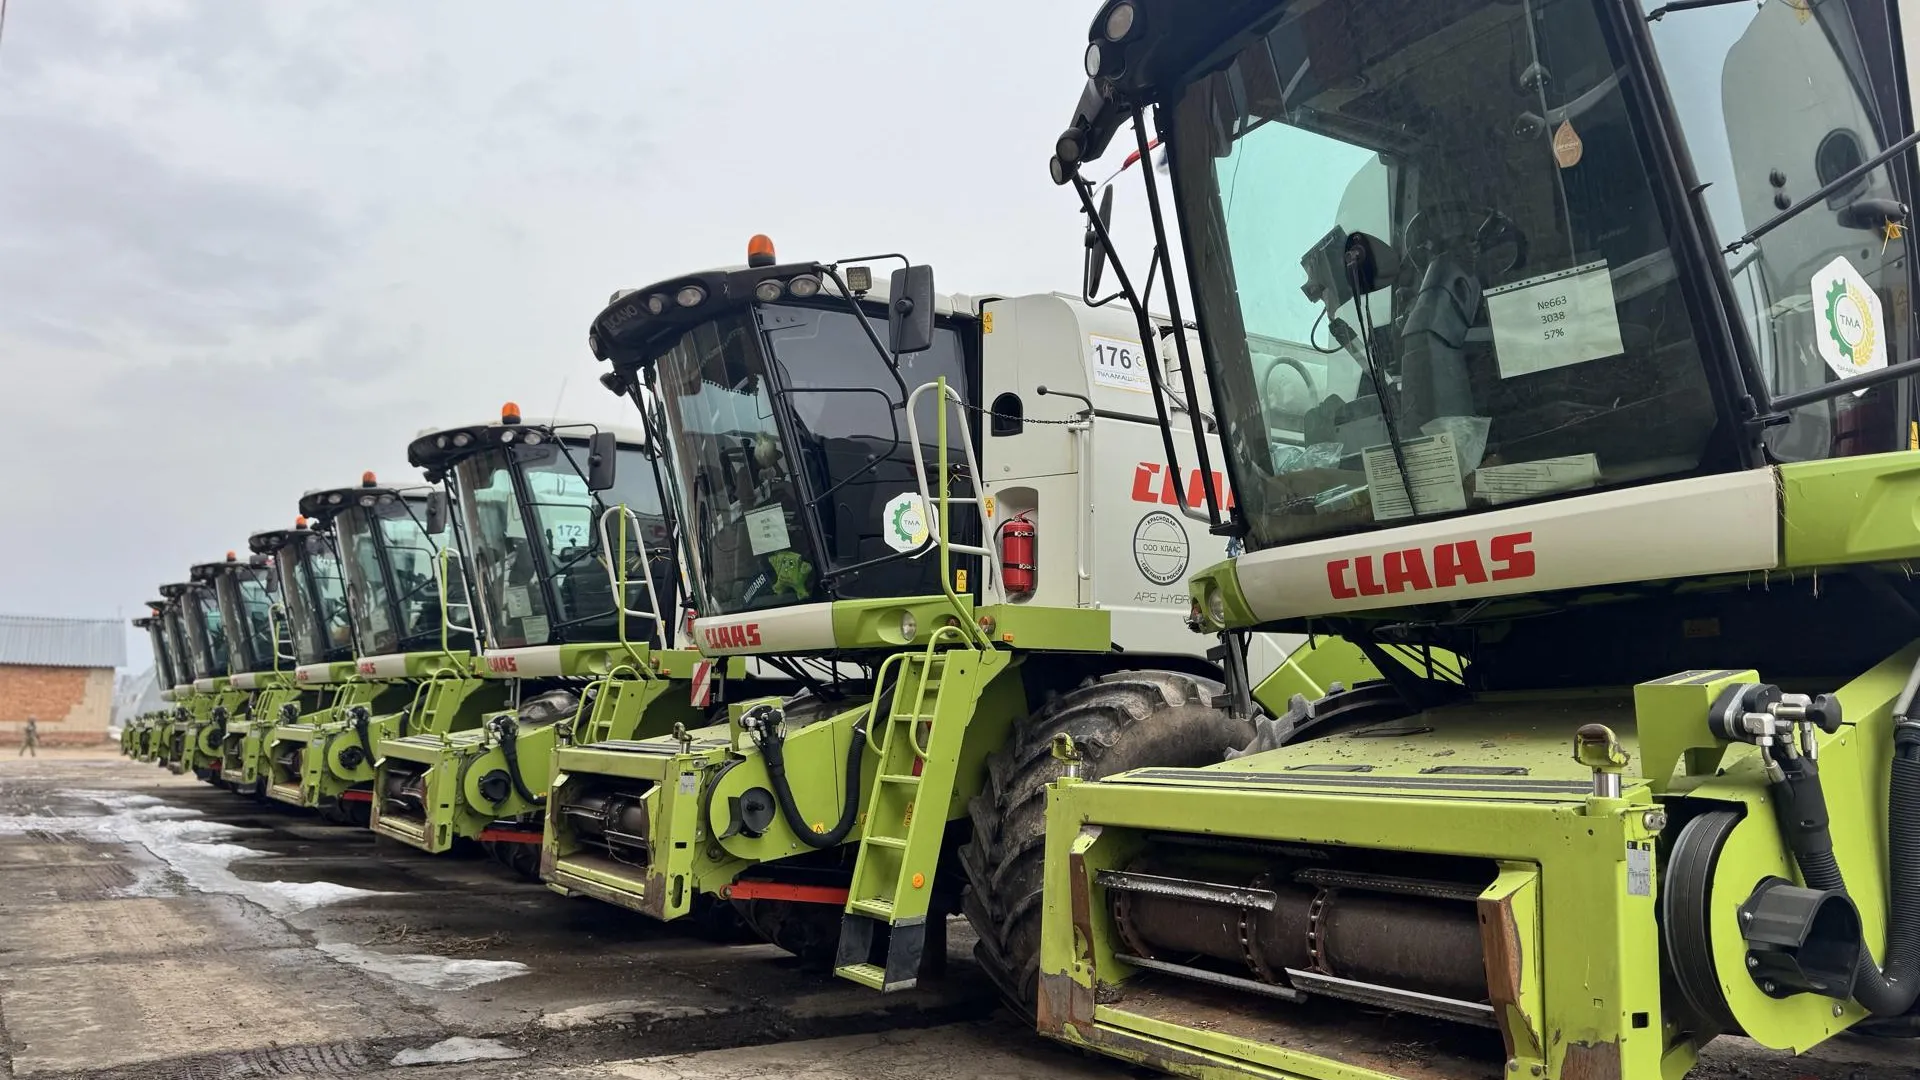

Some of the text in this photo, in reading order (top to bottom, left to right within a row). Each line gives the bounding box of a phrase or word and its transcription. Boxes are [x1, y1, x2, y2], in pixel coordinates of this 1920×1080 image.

[1537, 295, 1567, 311] №663
[1540, 311, 1566, 325] 3038
[1543, 327, 1565, 340] 57%
[1096, 343, 1132, 369] 176
[1131, 461, 1235, 511] CLA
[557, 524, 582, 537] 172
[1327, 531, 1536, 600] CLAAS
[1134, 591, 1157, 603] APS
[704, 623, 762, 649] CLAAS
